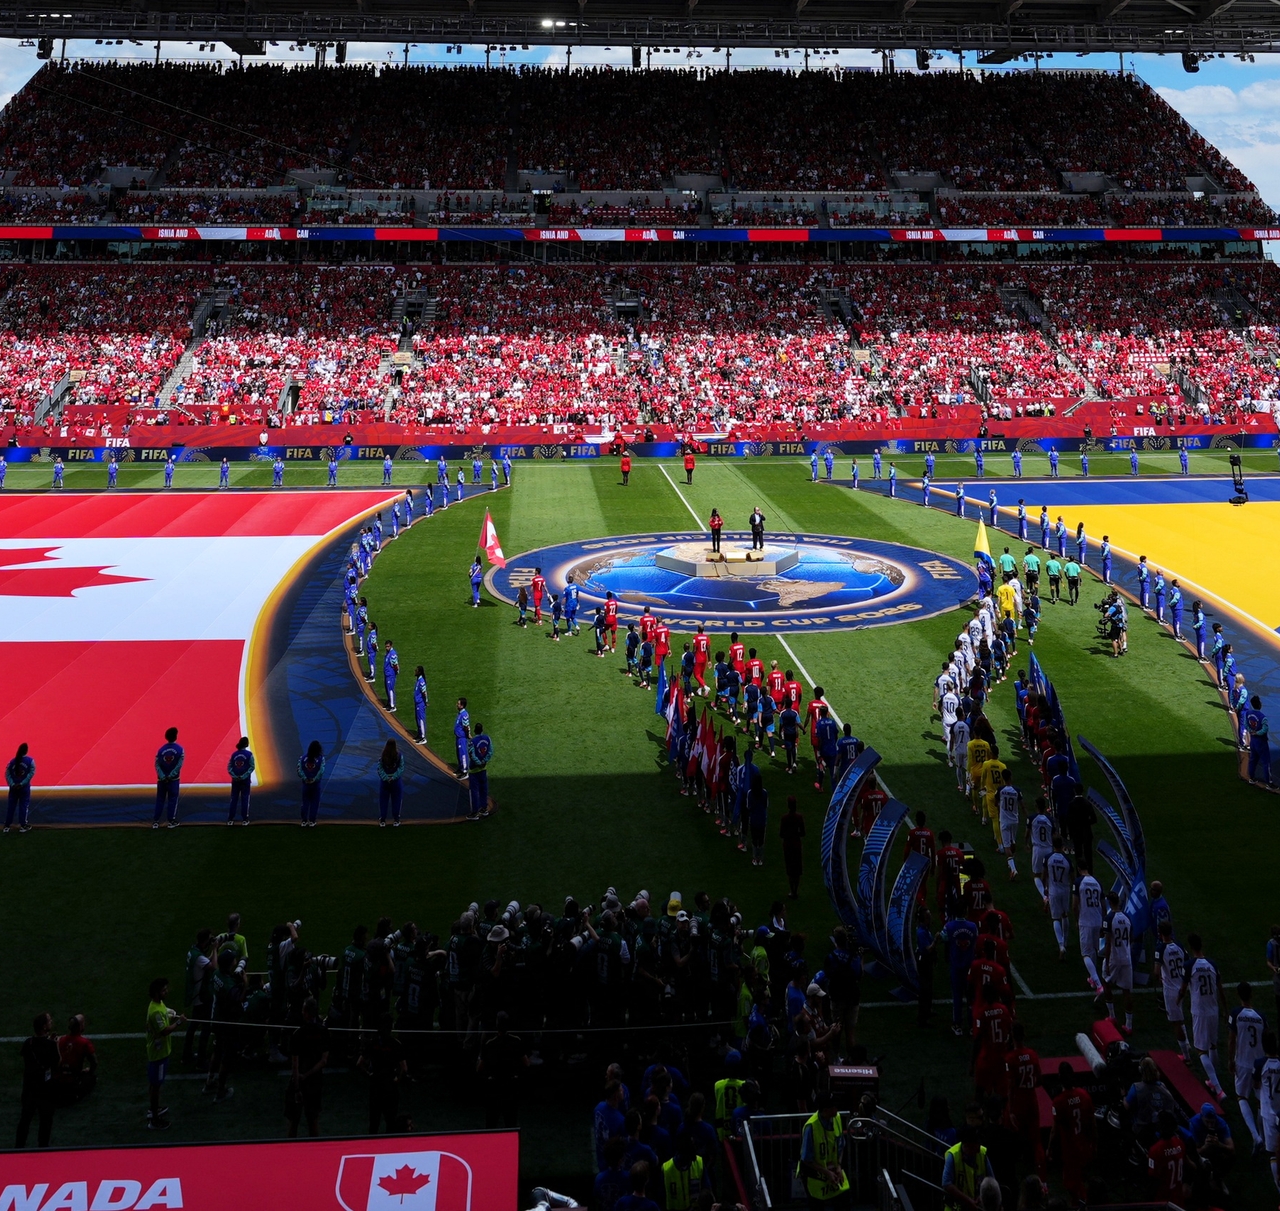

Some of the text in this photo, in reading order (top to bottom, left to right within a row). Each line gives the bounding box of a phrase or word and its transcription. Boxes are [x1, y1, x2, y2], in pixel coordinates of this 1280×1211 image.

[176, 229, 188, 237] AND
[297, 229, 309, 238] CAN
[557, 231, 569, 239] AND
[673, 231, 684, 239] CAN
[922, 231, 933, 239] AND
[1033, 231, 1044, 239] CAN
[1269, 230, 1280, 238] AND
[1133, 427, 1156, 436] FIFA
[105, 438, 130, 447] FIFA
[914, 441, 939, 451] FIFA
[981, 440, 1006, 450] FIFA
[1112, 439, 1135, 449] FIFA
[1177, 437, 1201, 447] FIFA
[359, 448, 385, 457] FIFA
[500, 446, 526, 457] FIFA
[570, 445, 597, 455] FIFA
[710, 444, 736, 455] FIFA
[779, 443, 804, 453] FIFA
[68, 450, 95, 460] FIFA
[141, 450, 168, 460] FIFA
[286, 449, 312, 459] FIFA
[581, 537, 658, 550] 2026
[919, 560, 962, 580] FIFA
[537, 582, 542, 590] 7
[658, 602, 923, 627] WORLD CUP 2026
[647, 621, 652, 632] 2
[660, 632, 666, 643] 4
[700, 641, 707, 652] 13
[736, 650, 744, 661] 12
[752, 666, 761, 678] 10
[774, 679, 781, 690] 11
[790, 689, 797, 702] 8
[945, 701, 955, 714] 10
[826, 726, 830, 740] 1
[959, 730, 965, 744] 7
[847, 744, 856, 760] 18
[975, 749, 986, 763] 22
[991, 770, 1001, 784] 12
[872, 800, 883, 817] 14
[1004, 796, 1015, 812] 19
[1039, 826, 1046, 842] 8
[920, 838, 926, 855] 6
[1051, 865, 1065, 883] 17
[1085, 888, 1099, 908] 23
[1114, 927, 1129, 947] 24
[1168, 957, 1183, 979] 26
[1198, 974, 1213, 997] 21
[990, 1018, 1003, 1043] 15
[1247, 1025, 1257, 1048] 3
[1019, 1064, 1034, 1089] 23
[1072, 1108, 1082, 1136] 3
[1168, 1157, 1184, 1190] 24
